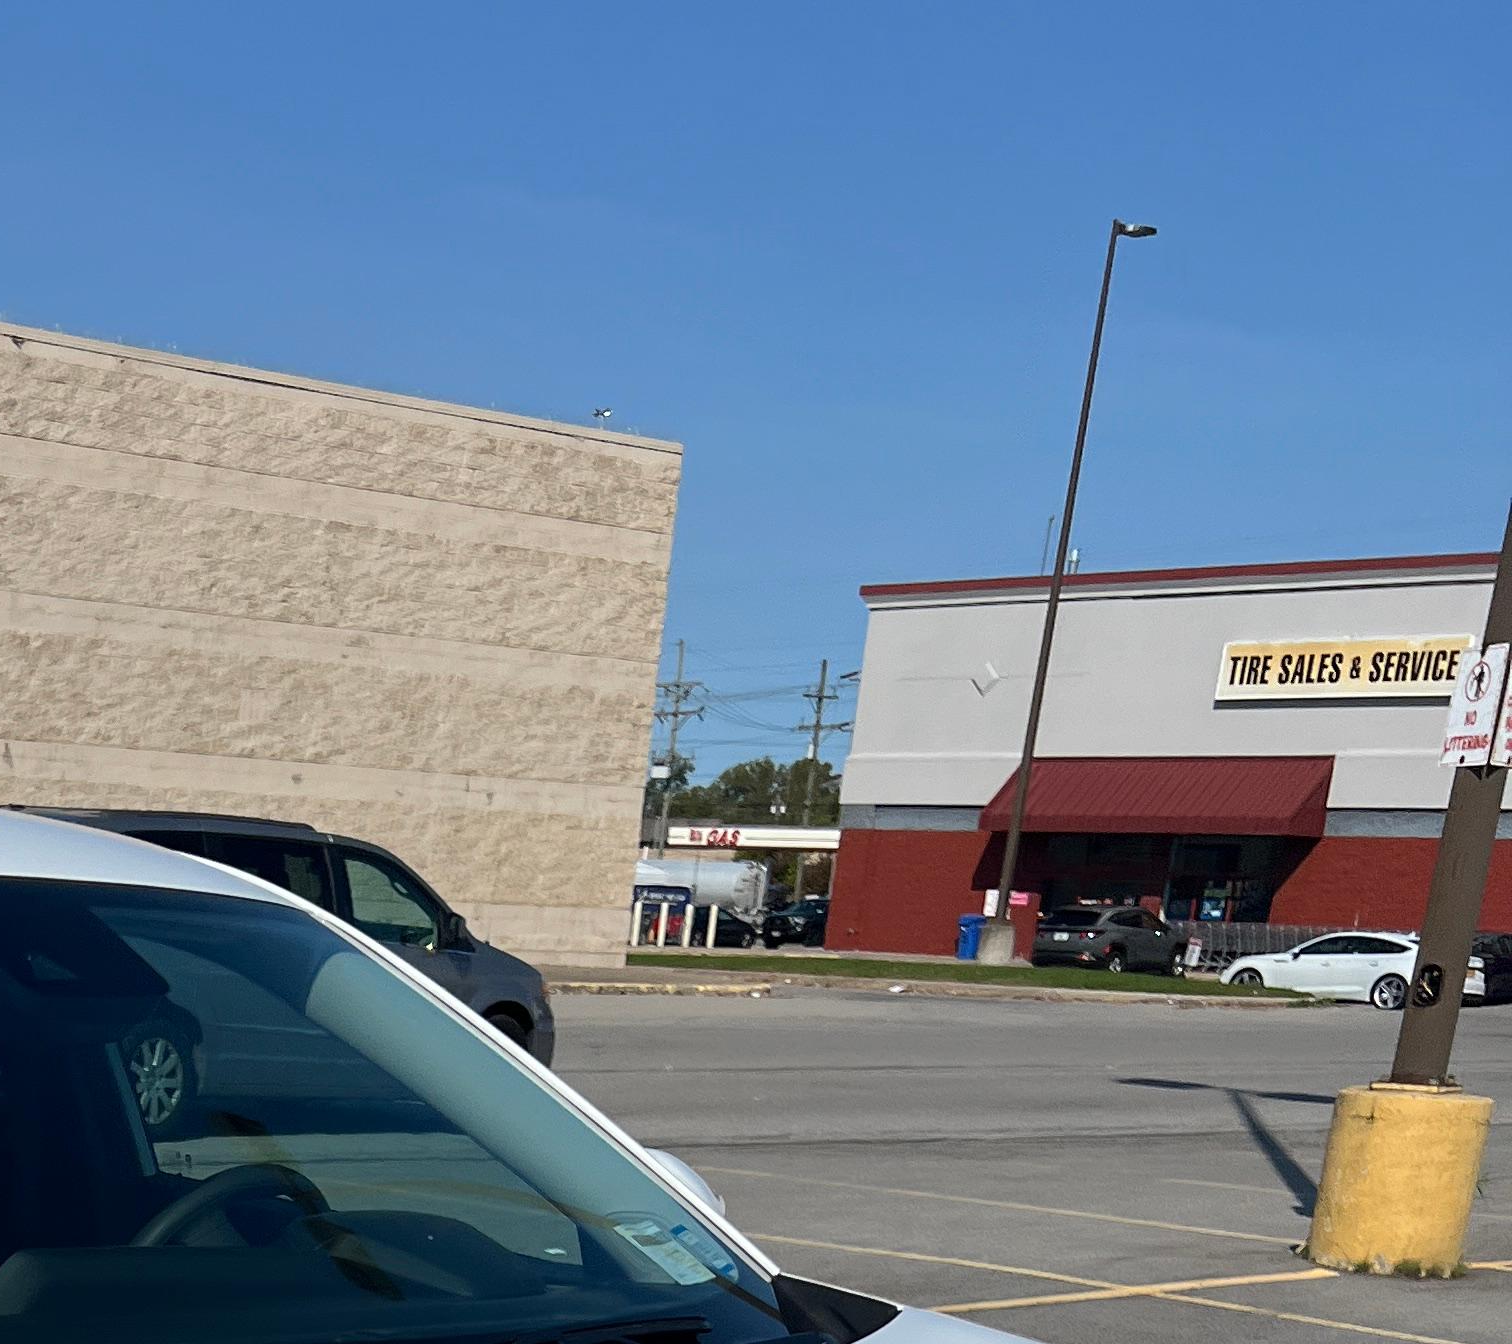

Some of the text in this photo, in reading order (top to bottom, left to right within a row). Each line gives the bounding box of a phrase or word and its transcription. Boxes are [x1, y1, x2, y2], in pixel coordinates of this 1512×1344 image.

[1228, 649, 1460, 685] TIRE SALES & SERVICE
[707, 829, 740, 847] GAS
